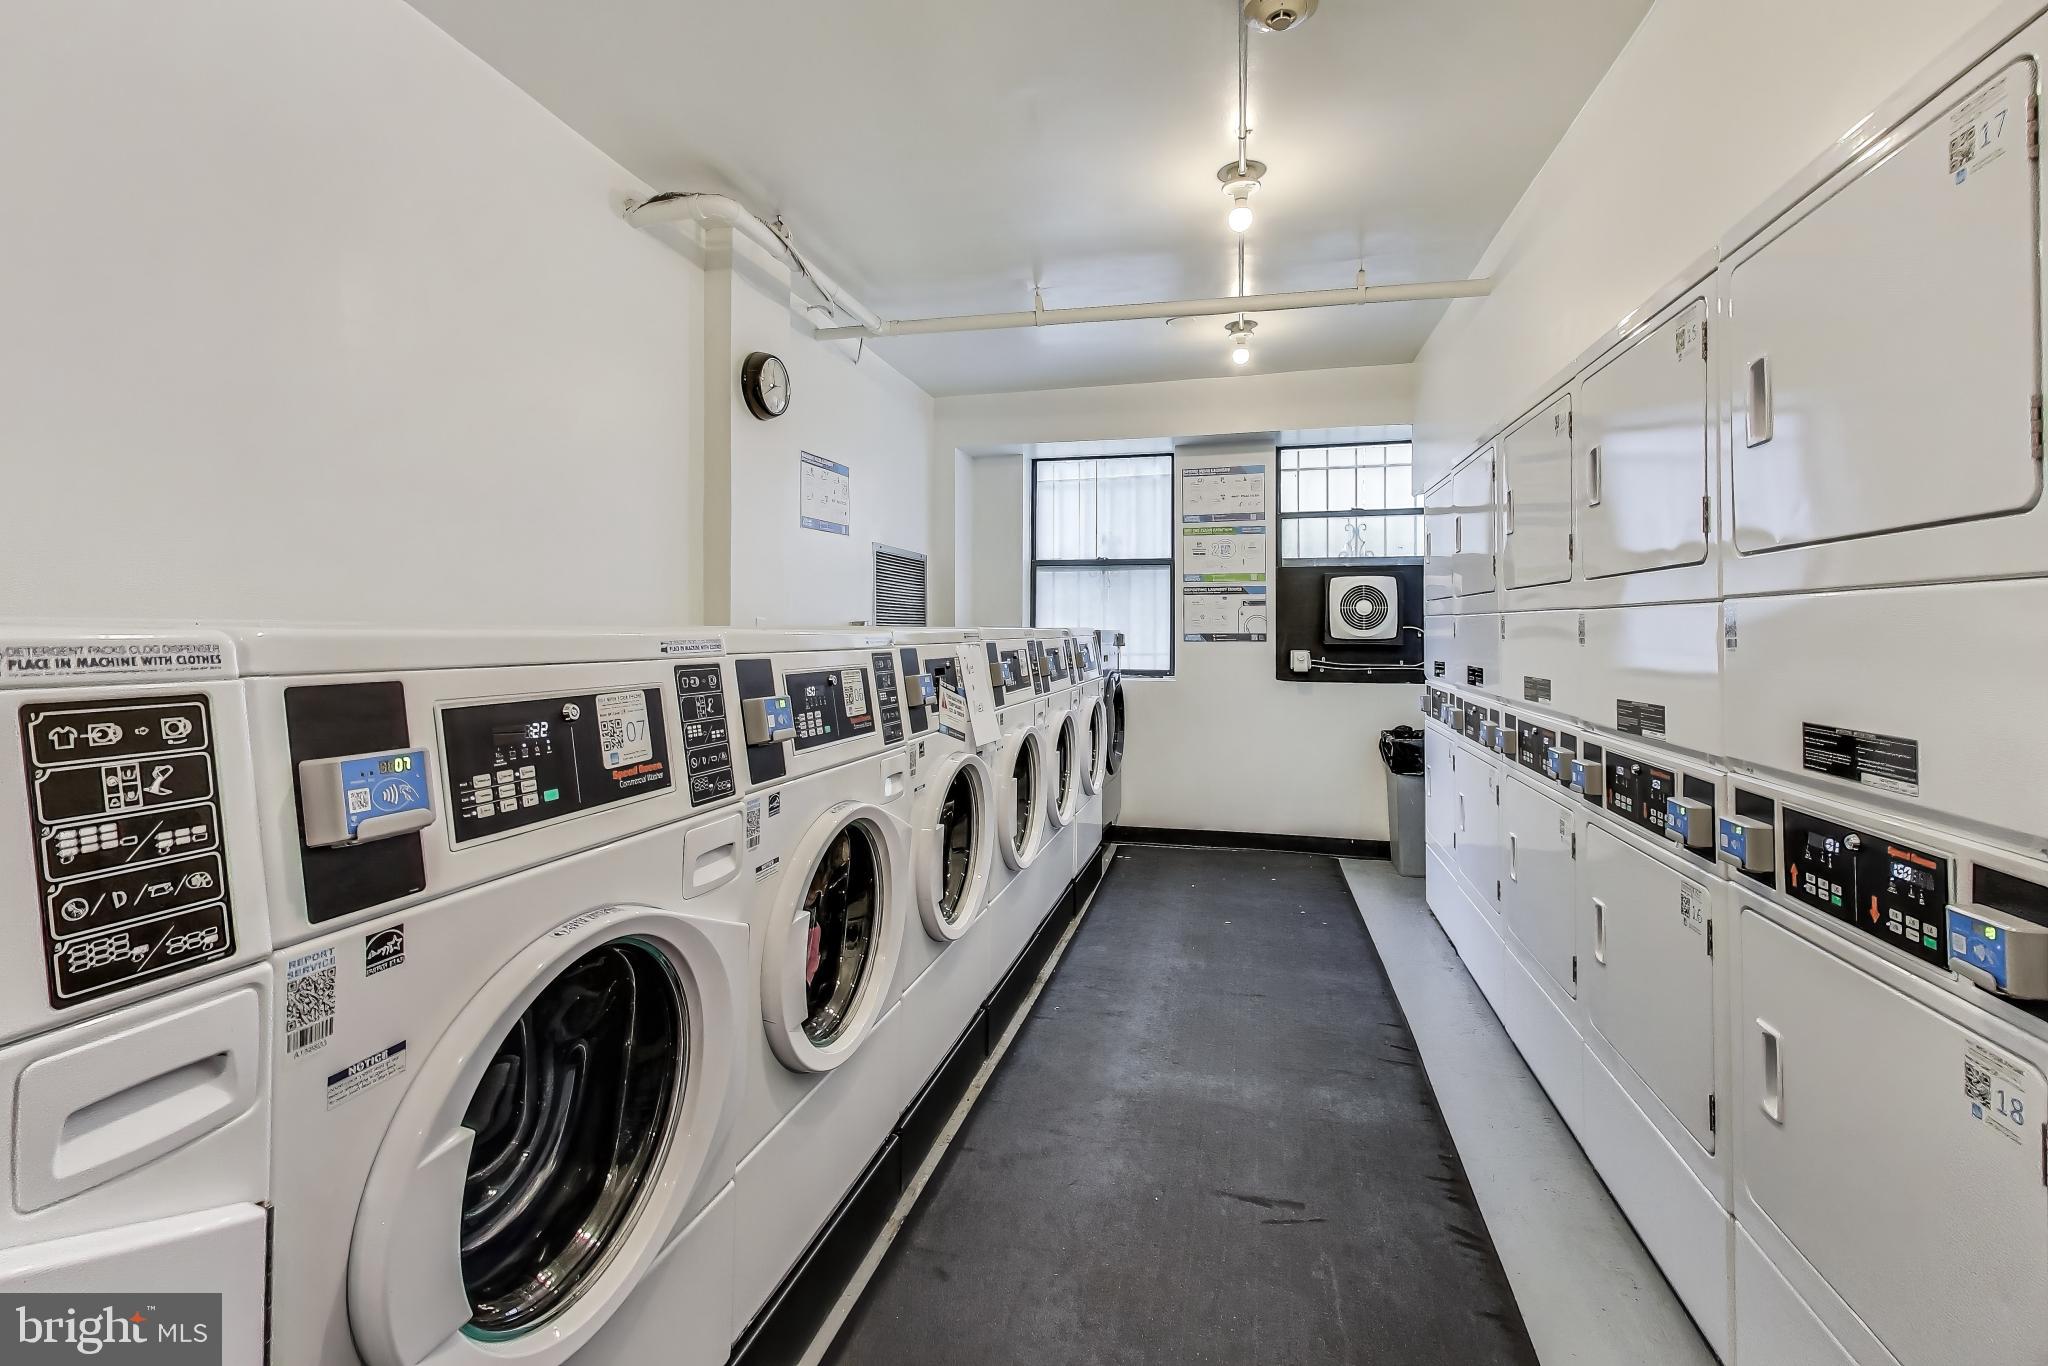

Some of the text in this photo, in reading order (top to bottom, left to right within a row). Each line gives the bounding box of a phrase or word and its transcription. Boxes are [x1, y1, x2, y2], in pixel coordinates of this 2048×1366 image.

[1980, 108, 2008, 149] 17
[8, 654, 222, 670] PLACE IN MACHINE WITH CLOTHES
[626, 720, 645, 742] 07
[288, 947, 335, 969] REPORT
[348, 1050, 389, 1077] NOTICE
[1997, 1090, 2024, 1125] 18
